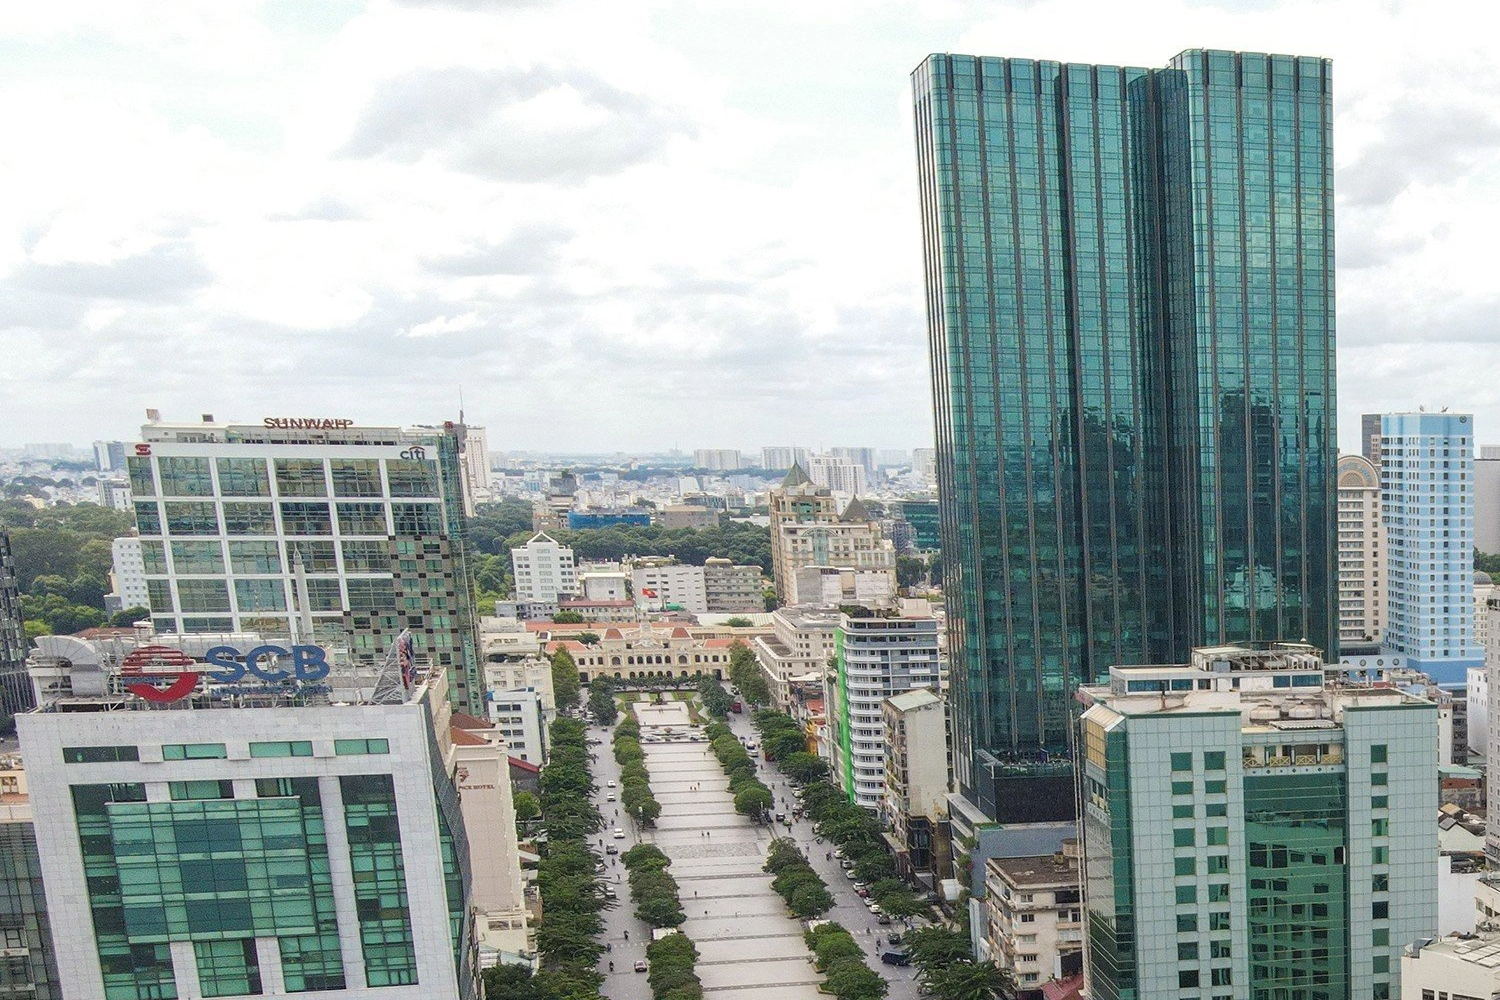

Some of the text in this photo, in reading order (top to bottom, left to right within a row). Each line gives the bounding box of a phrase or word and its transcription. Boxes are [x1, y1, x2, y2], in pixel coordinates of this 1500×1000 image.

[264, 417, 348, 430] SUNWAH
[400, 446, 425, 460] citi
[204, 644, 330, 682] SCB
